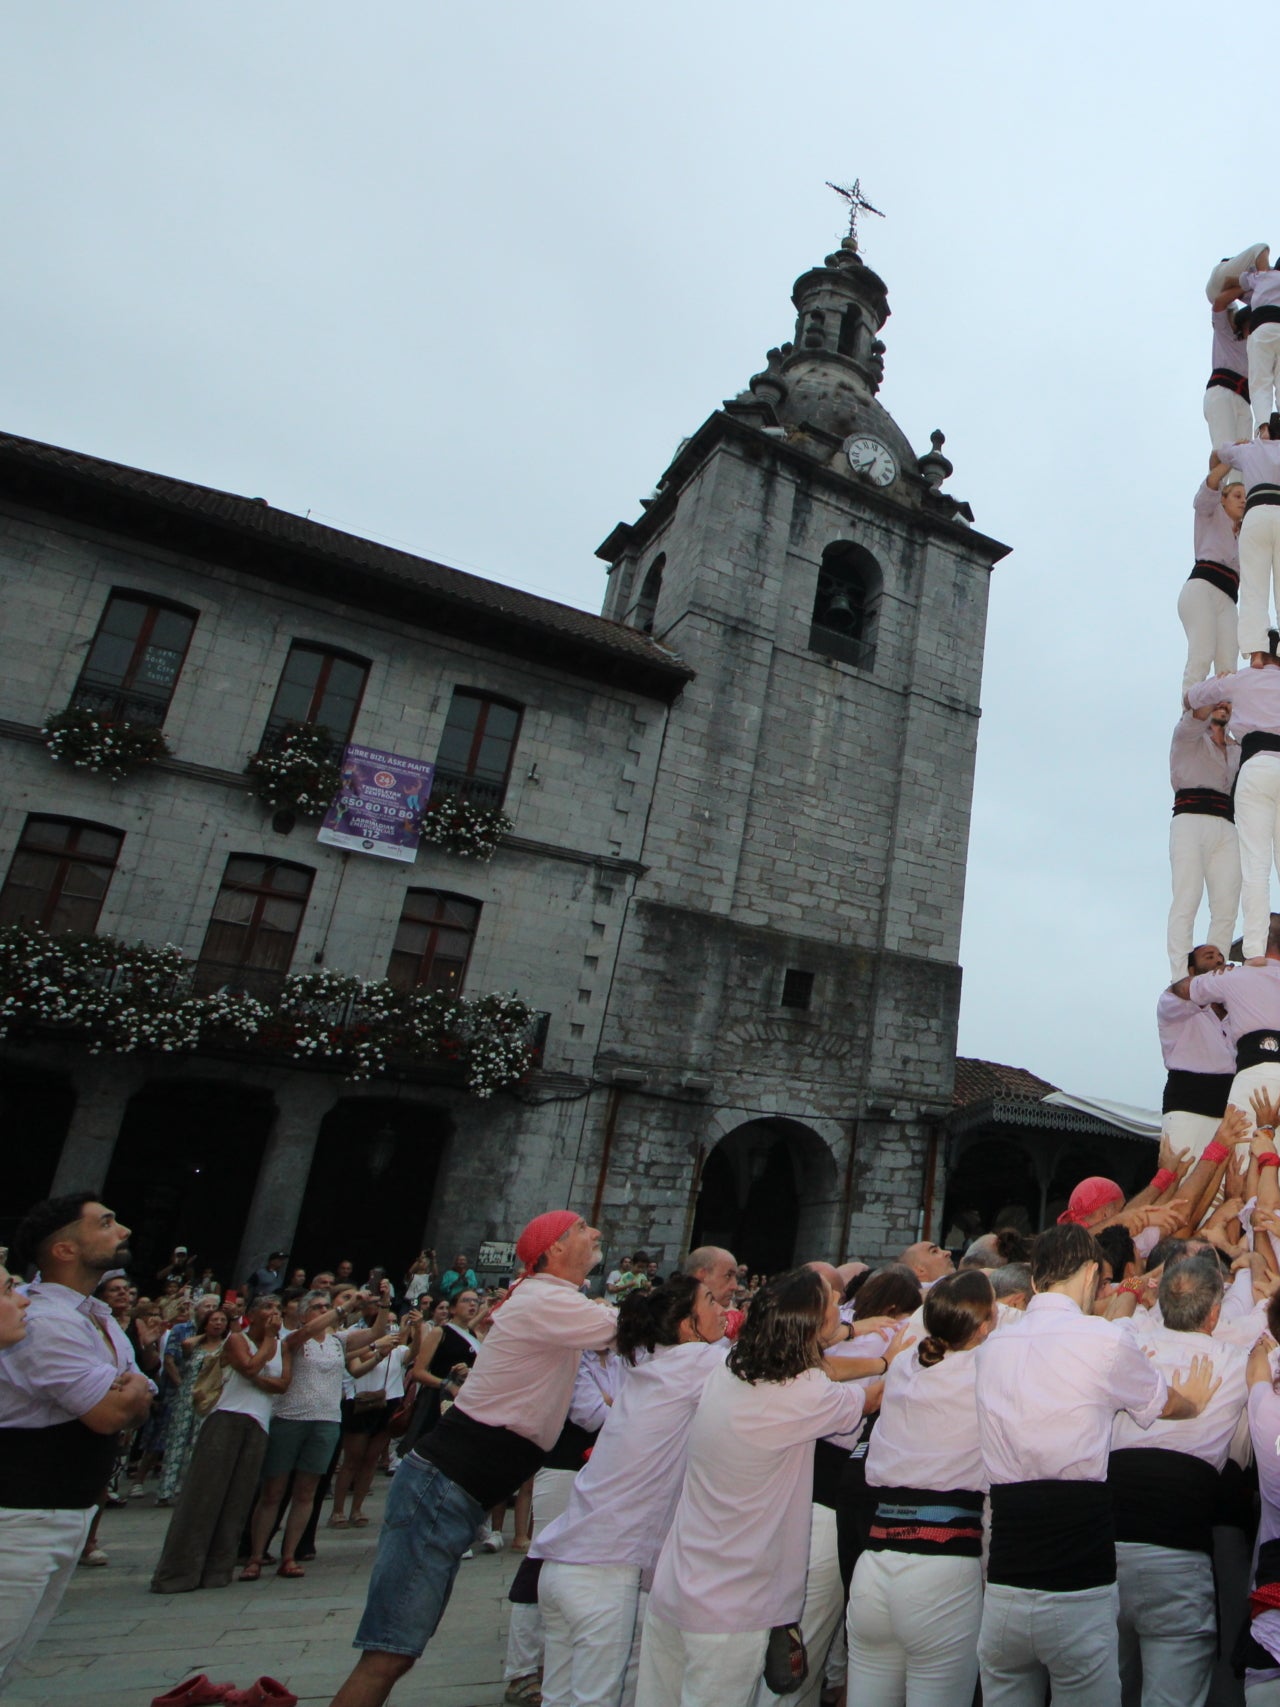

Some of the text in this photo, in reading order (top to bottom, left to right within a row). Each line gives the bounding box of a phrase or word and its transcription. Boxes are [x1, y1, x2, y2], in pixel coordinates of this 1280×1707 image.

[347, 747, 368, 758] LIBRE
[387, 757, 406, 768] ASKE
[408, 762, 431, 774] MAITE
[341, 796, 364, 807] 650
[383, 806, 397, 815] 10
[399, 810, 414, 819] 80
[362, 828, 380, 839] 112
